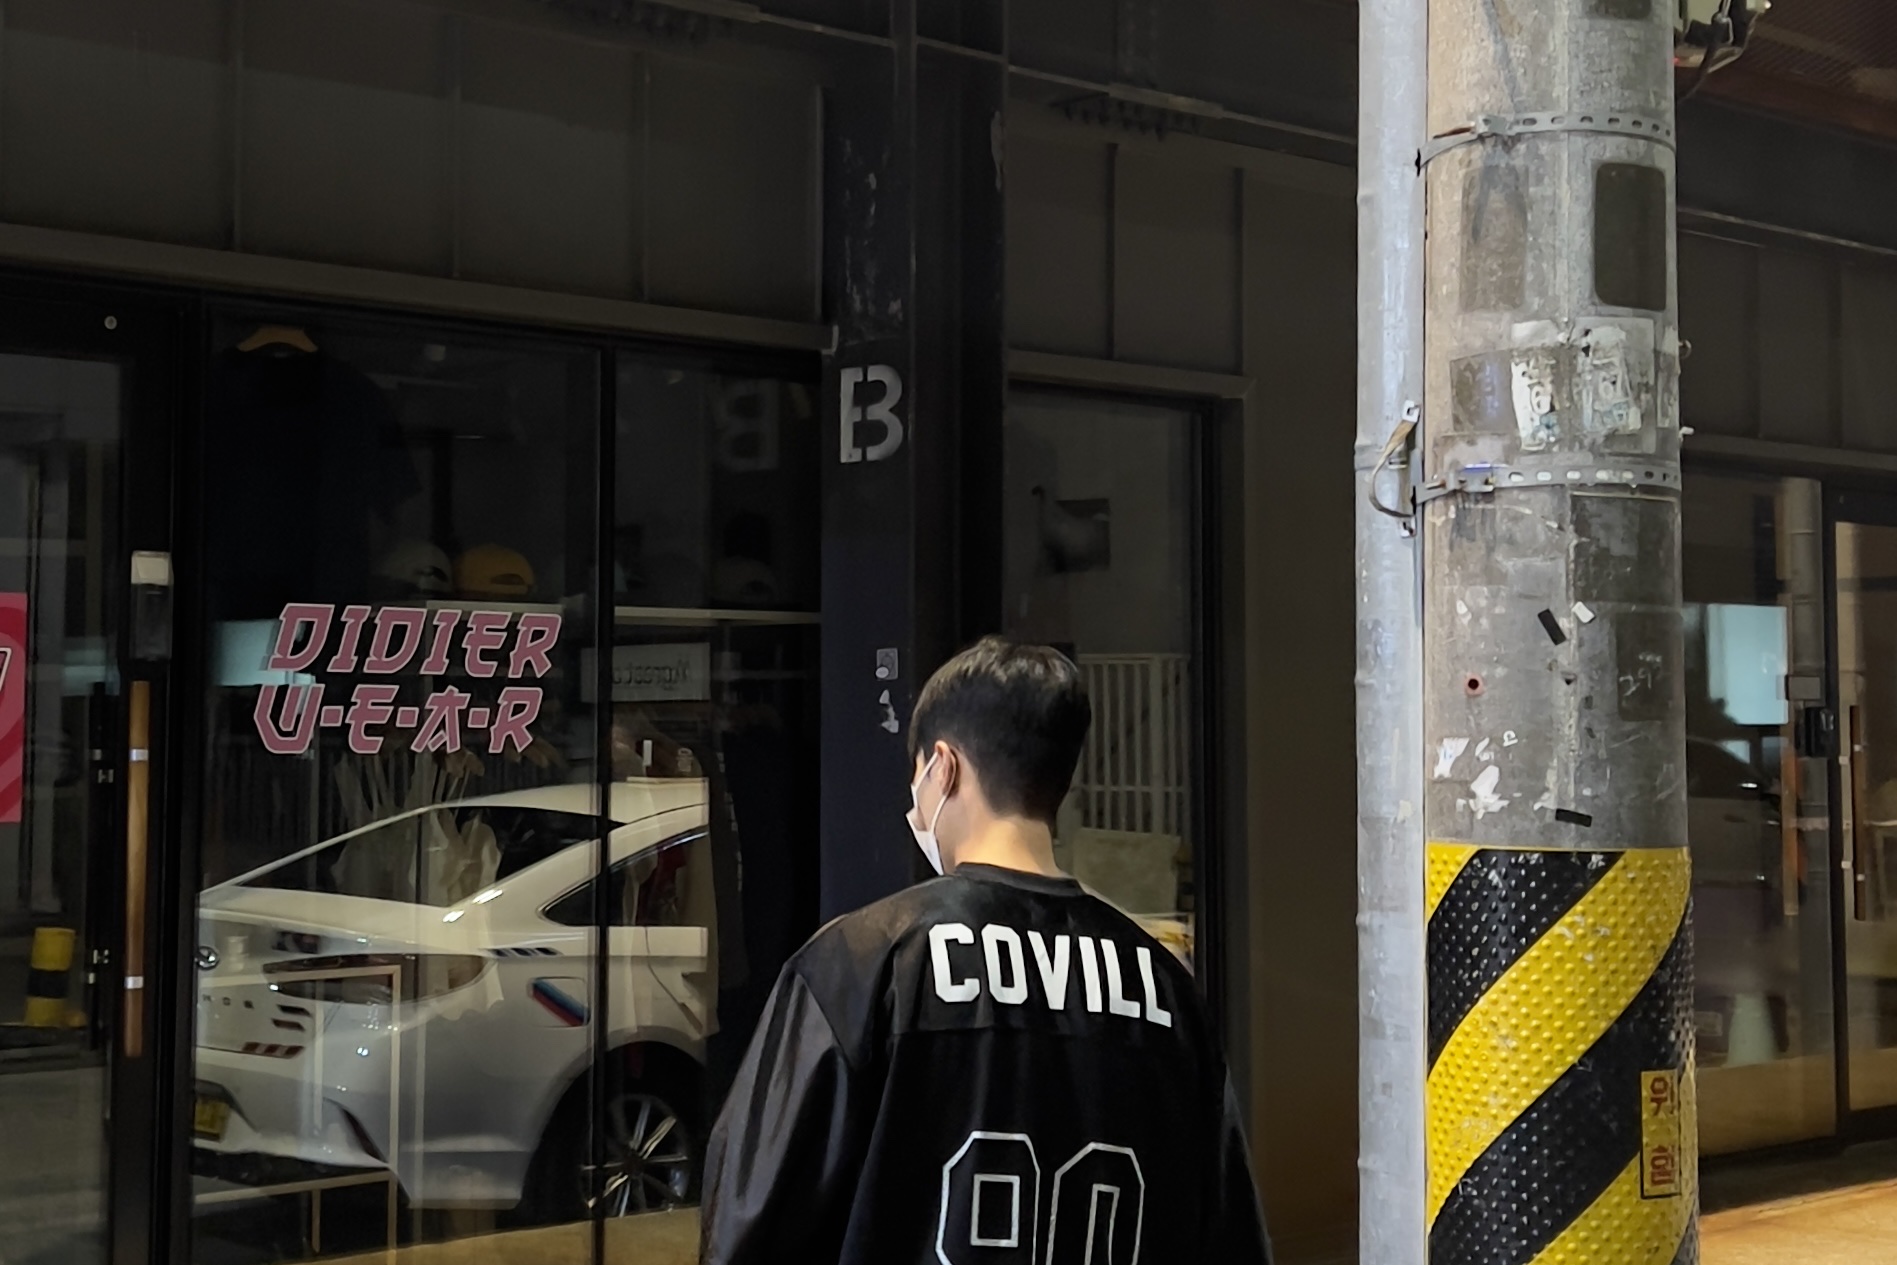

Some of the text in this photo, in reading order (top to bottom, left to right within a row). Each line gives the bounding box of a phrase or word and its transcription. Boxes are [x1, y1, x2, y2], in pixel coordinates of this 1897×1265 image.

[839, 364, 902, 464] B
[268, 602, 562, 678] DIDIER
[928, 922, 1173, 1028] COVILL
